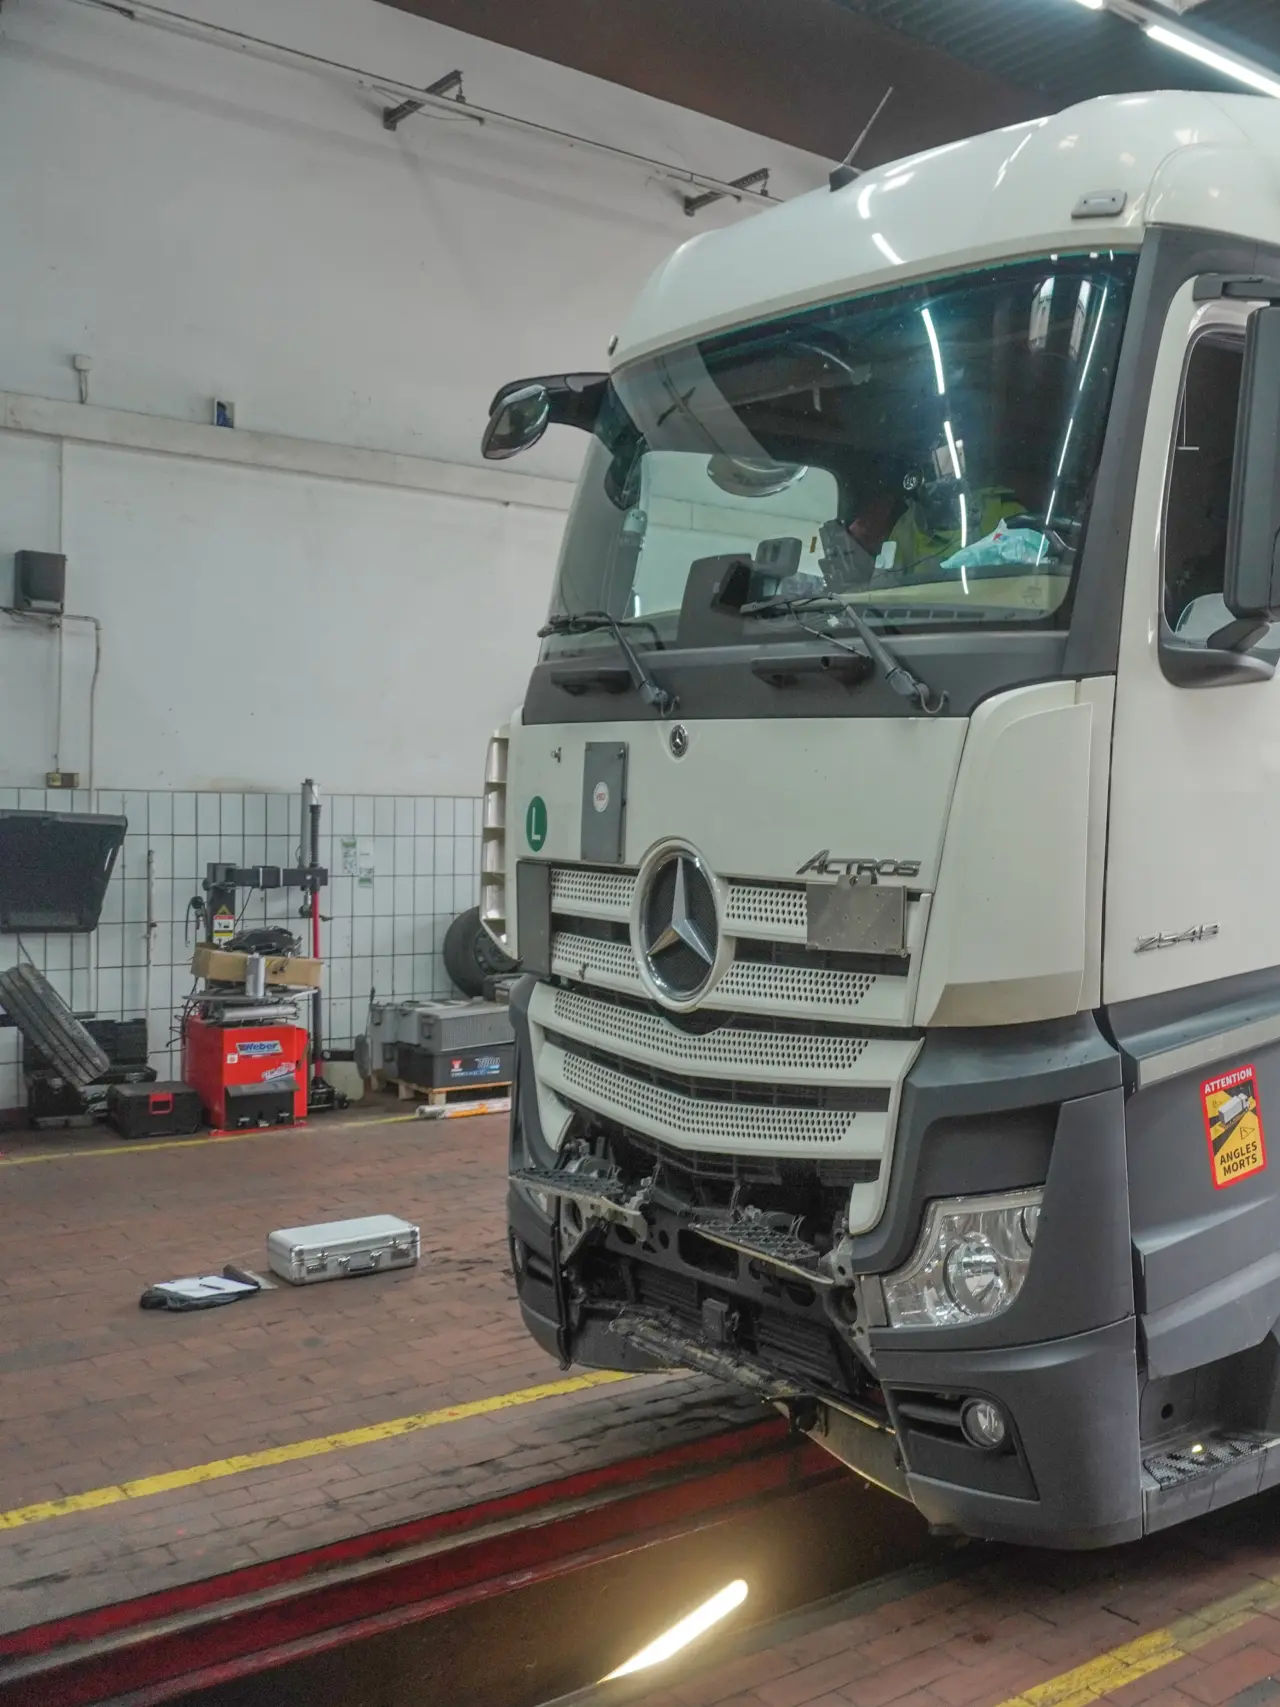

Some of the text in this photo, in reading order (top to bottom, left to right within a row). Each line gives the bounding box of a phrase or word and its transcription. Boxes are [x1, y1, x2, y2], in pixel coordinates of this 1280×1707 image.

[531, 806, 541, 840] L
[796, 849, 921, 884] ACTROS
[245, 1042, 278, 1051] Weber
[1204, 1067, 1253, 1094] ATTENTION
[1219, 1141, 1258, 1166] ANGLES
[1223, 1153, 1258, 1177] MORTS
